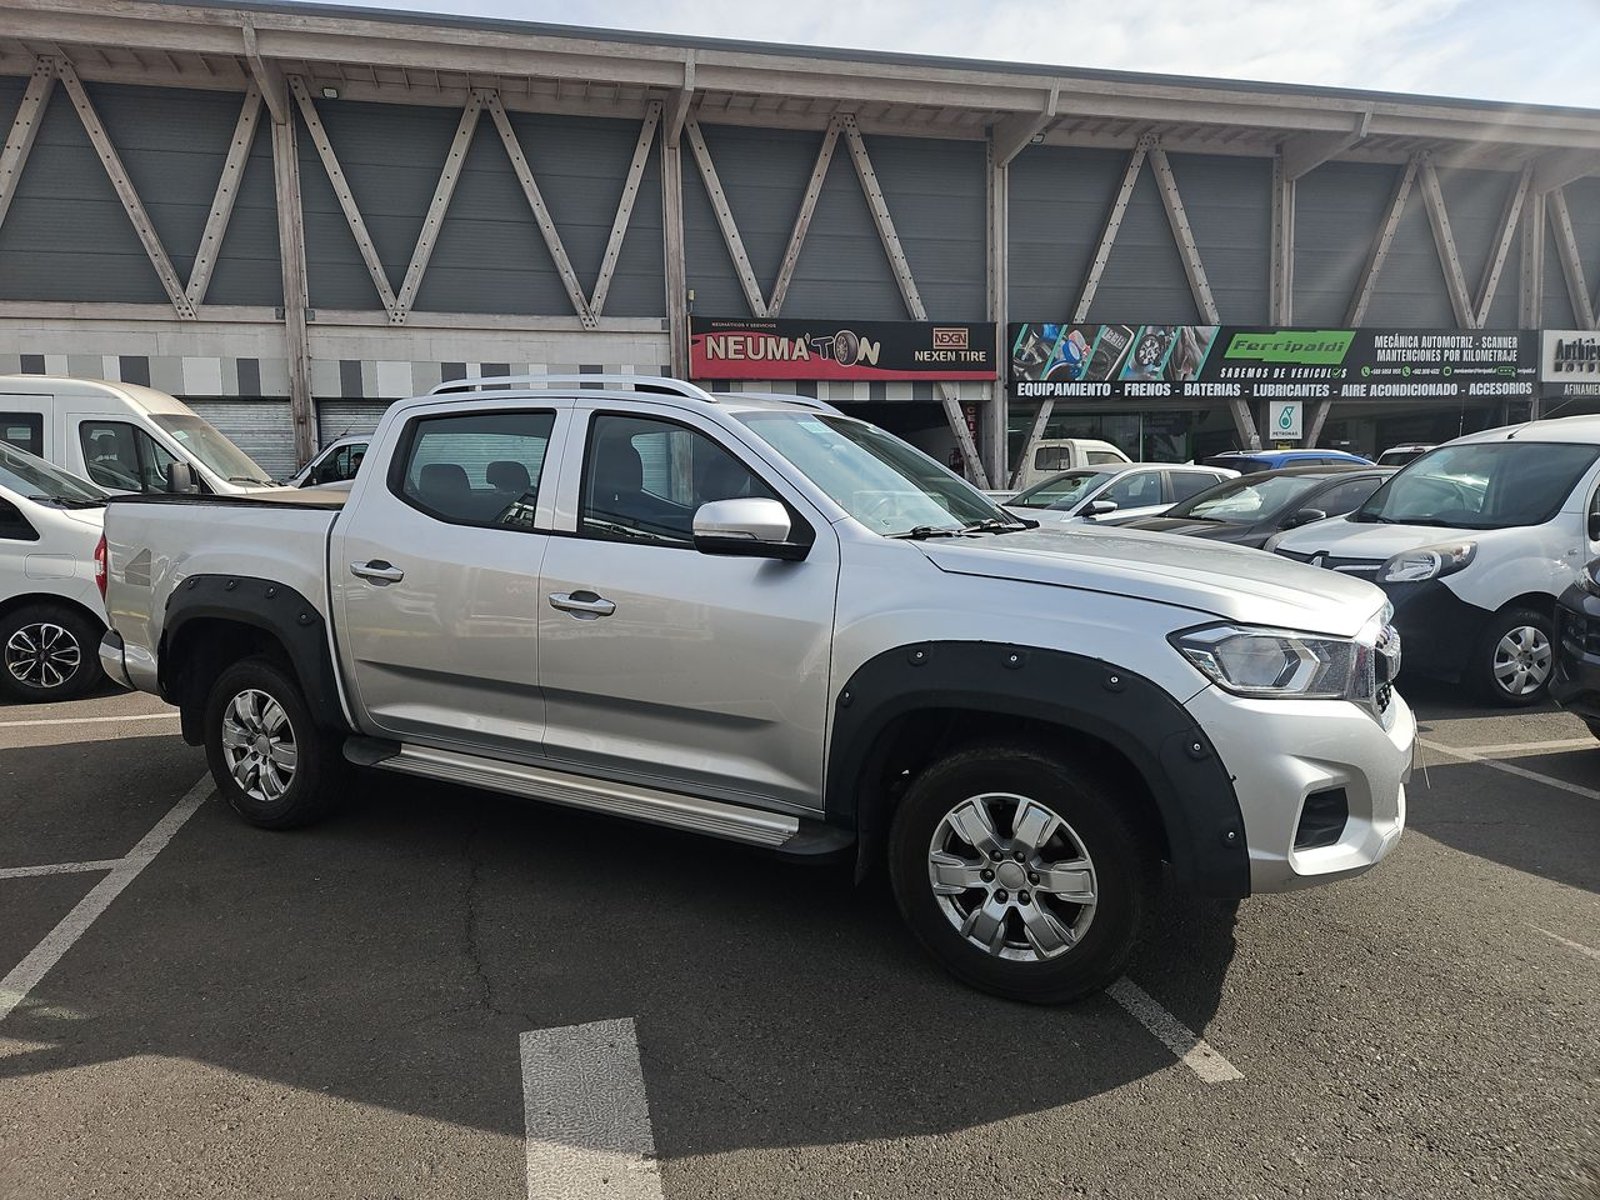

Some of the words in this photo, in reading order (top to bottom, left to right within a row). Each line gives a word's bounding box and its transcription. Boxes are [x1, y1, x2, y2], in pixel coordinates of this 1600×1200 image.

[934, 333, 967, 344] NEXEN
[1374, 333, 1419, 348] MECÁNICA
[1421, 336, 1473, 348] AUTOMOTRIZ
[1481, 336, 1518, 348] SCANNER
[1233, 340, 1345, 353] Ferripaldi
[914, 350, 956, 362] NEXEN
[959, 351, 987, 362] TIRE
[1376, 350, 1441, 362] MANTENCIONES
[1443, 350, 1460, 362] POR
[1462, 350, 1517, 362] KILOMETRAJE
[1219, 367, 1270, 378] SABEMOS
[1273, 368, 1287, 378] DE
[1017, 382, 1111, 397] EQUIPAMIENTO
[1124, 383, 1171, 397] FRENOS
[1183, 383, 1241, 397] BATERIAS
[1253, 384, 1331, 397] LUBRICANTES
[1341, 384, 1367, 397] AIRE
[1369, 383, 1458, 397] ACONDICIONADO
[1469, 382, 1533, 396] ACCESORIOS
